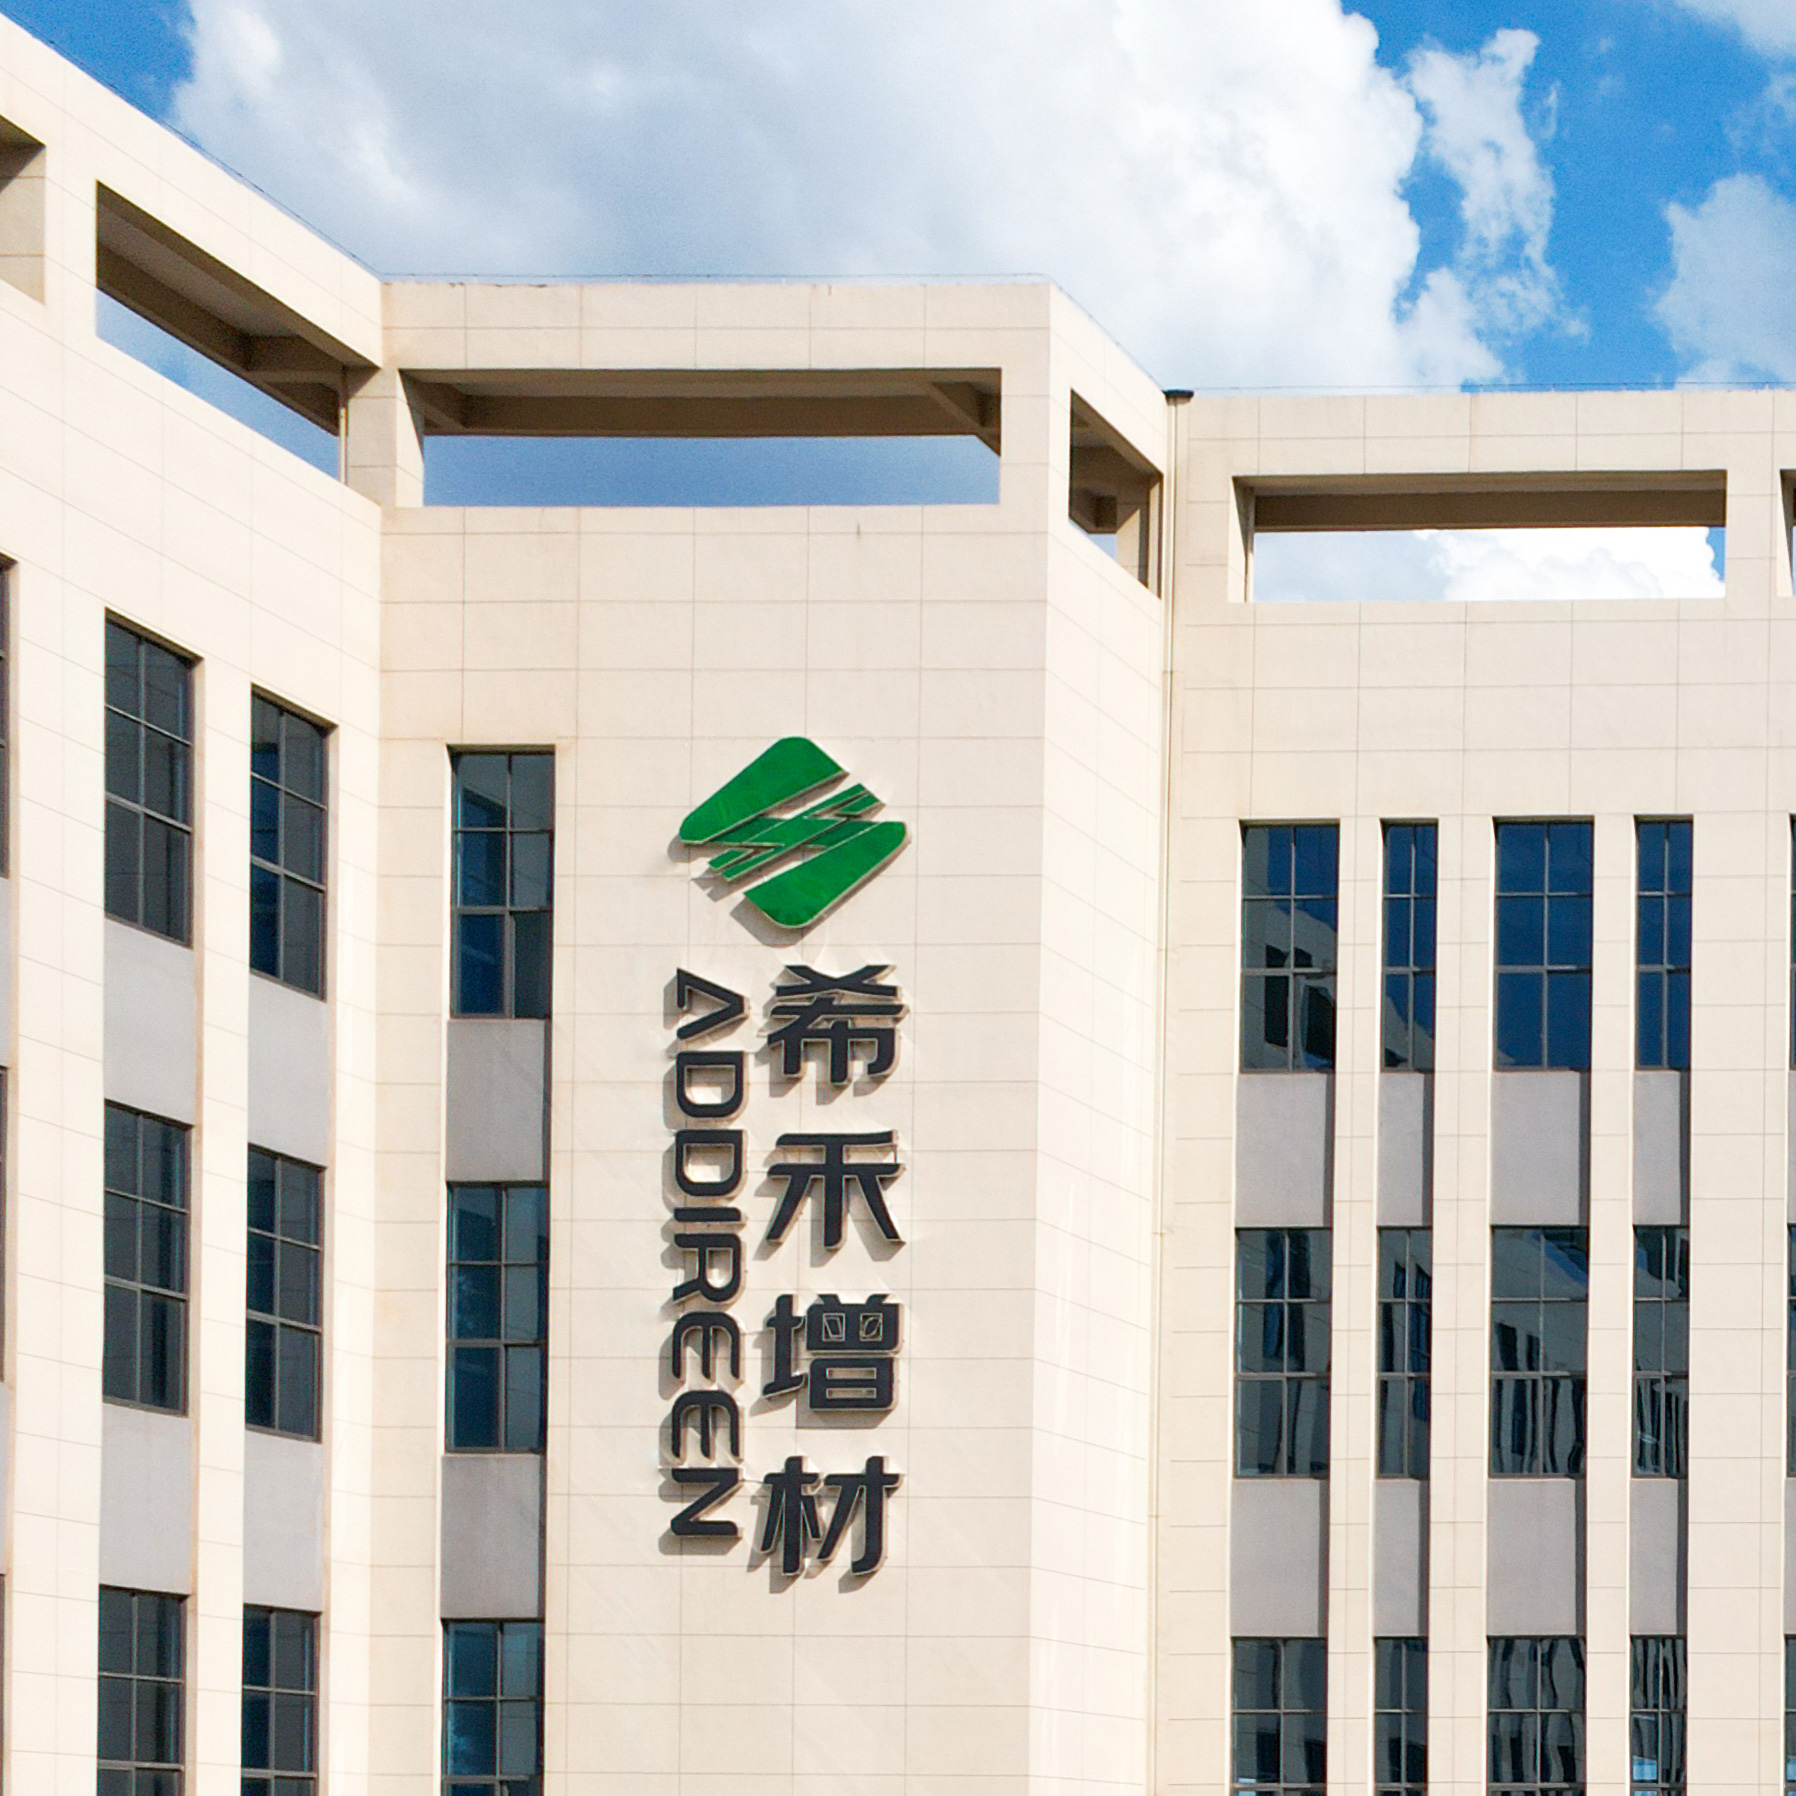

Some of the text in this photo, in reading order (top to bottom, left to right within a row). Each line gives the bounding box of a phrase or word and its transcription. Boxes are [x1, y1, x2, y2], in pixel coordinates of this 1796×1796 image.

[669, 966, 748, 1540] ADDIREEN
[761, 963, 906, 1577] 希禾增材
